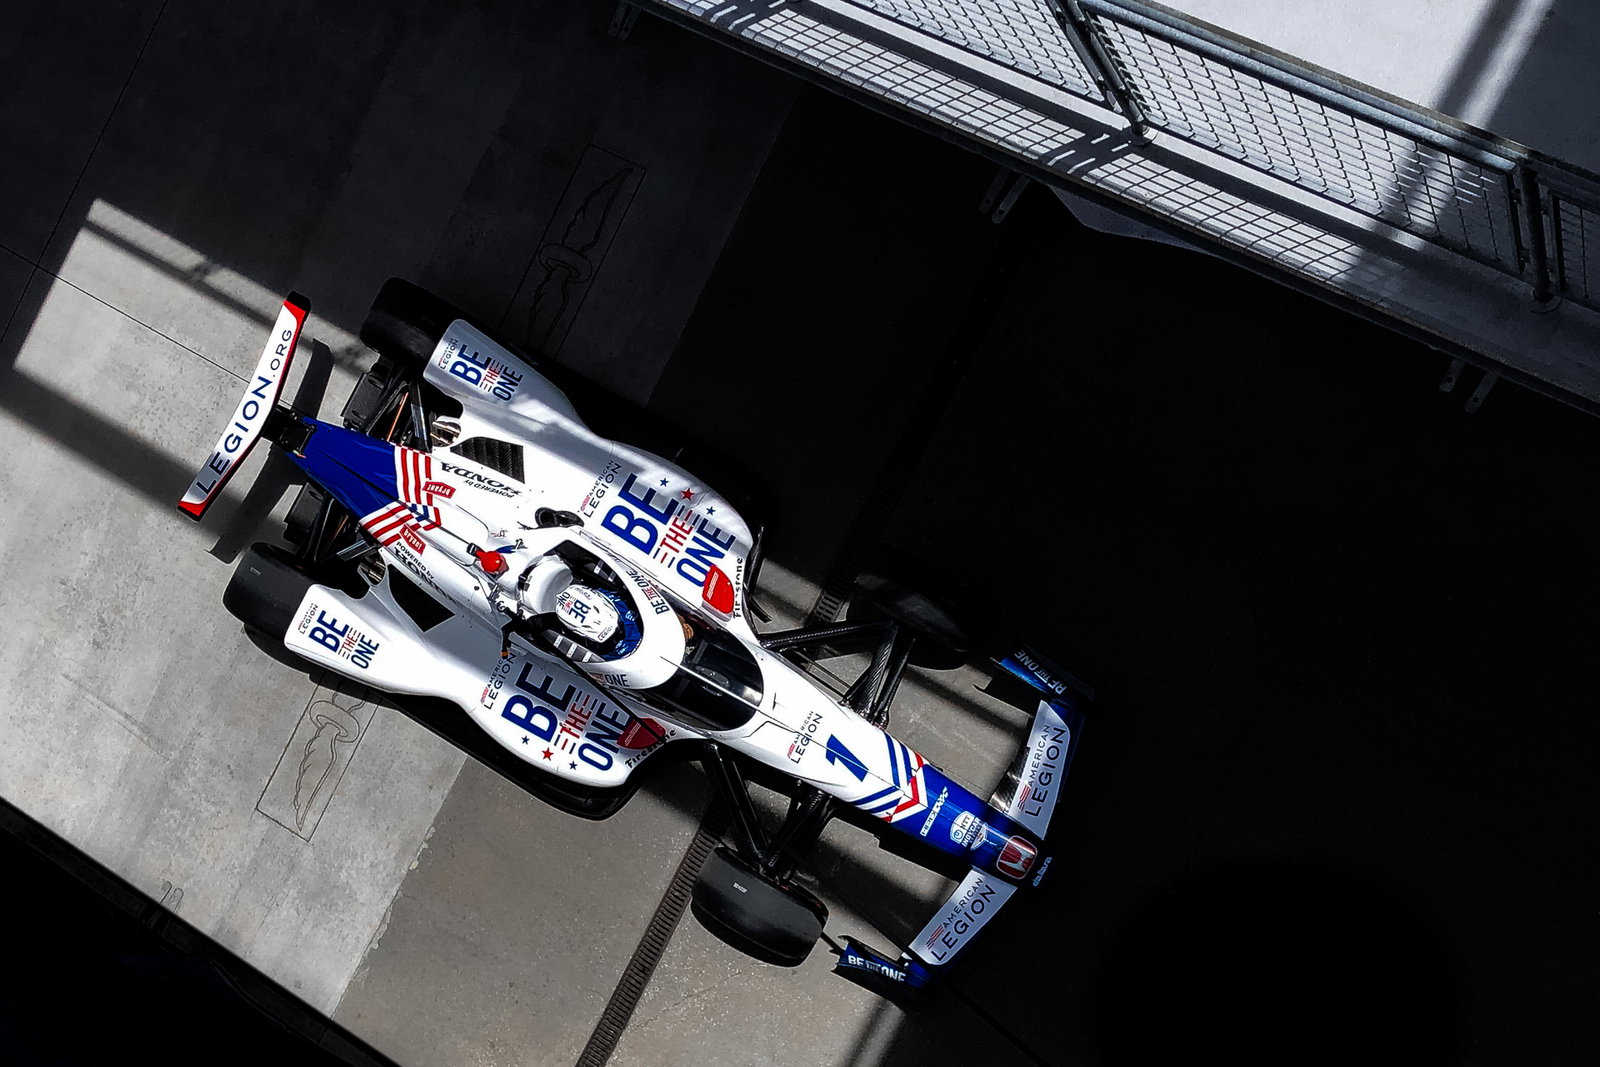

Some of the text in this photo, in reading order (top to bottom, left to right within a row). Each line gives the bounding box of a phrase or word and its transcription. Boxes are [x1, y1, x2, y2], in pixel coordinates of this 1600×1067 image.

[440, 339, 459, 370] LEGION
[449, 343, 492, 386] BE
[483, 365, 501, 385] THE
[492, 366, 524, 401] ONE
[195, 329, 293, 495] LEGION.ORG
[426, 483, 451, 496] bryant
[441, 461, 522, 495] HONDA
[473, 483, 515, 498] POWERED
[583, 462, 622, 518] LEGION
[589, 460, 613, 497] AMERICAN
[600, 472, 680, 555] BE
[403, 529, 423, 550] bryant
[660, 516, 694, 553] THE
[676, 517, 736, 588] ONE
[396, 541, 427, 572] POWERED
[626, 569, 649, 588] ONE
[299, 604, 319, 634] LEGION
[568, 599, 591, 624] BE
[651, 599, 670, 615] BE
[308, 610, 350, 653] BE
[341, 634, 358, 652] THE
[350, 634, 380, 669] ONE
[1014, 650, 1039, 671] ONE
[484, 653, 517, 709] LEGION
[606, 673, 630, 688] ONE
[501, 661, 577, 743] BE
[559, 702, 593, 739] THE
[577, 702, 634, 771] ONE
[790, 713, 823, 764] LEGION
[825, 733, 869, 782] 1
[1025, 727, 1067, 817] LEGION
[1028, 724, 1051, 787] AMERICAN
[961, 817, 982, 847] INDYCAR
[942, 877, 984, 929] AMERICAN
[931, 884, 997, 961] LEGION
[848, 954, 864, 967] BE
[881, 966, 907, 982] ONE
